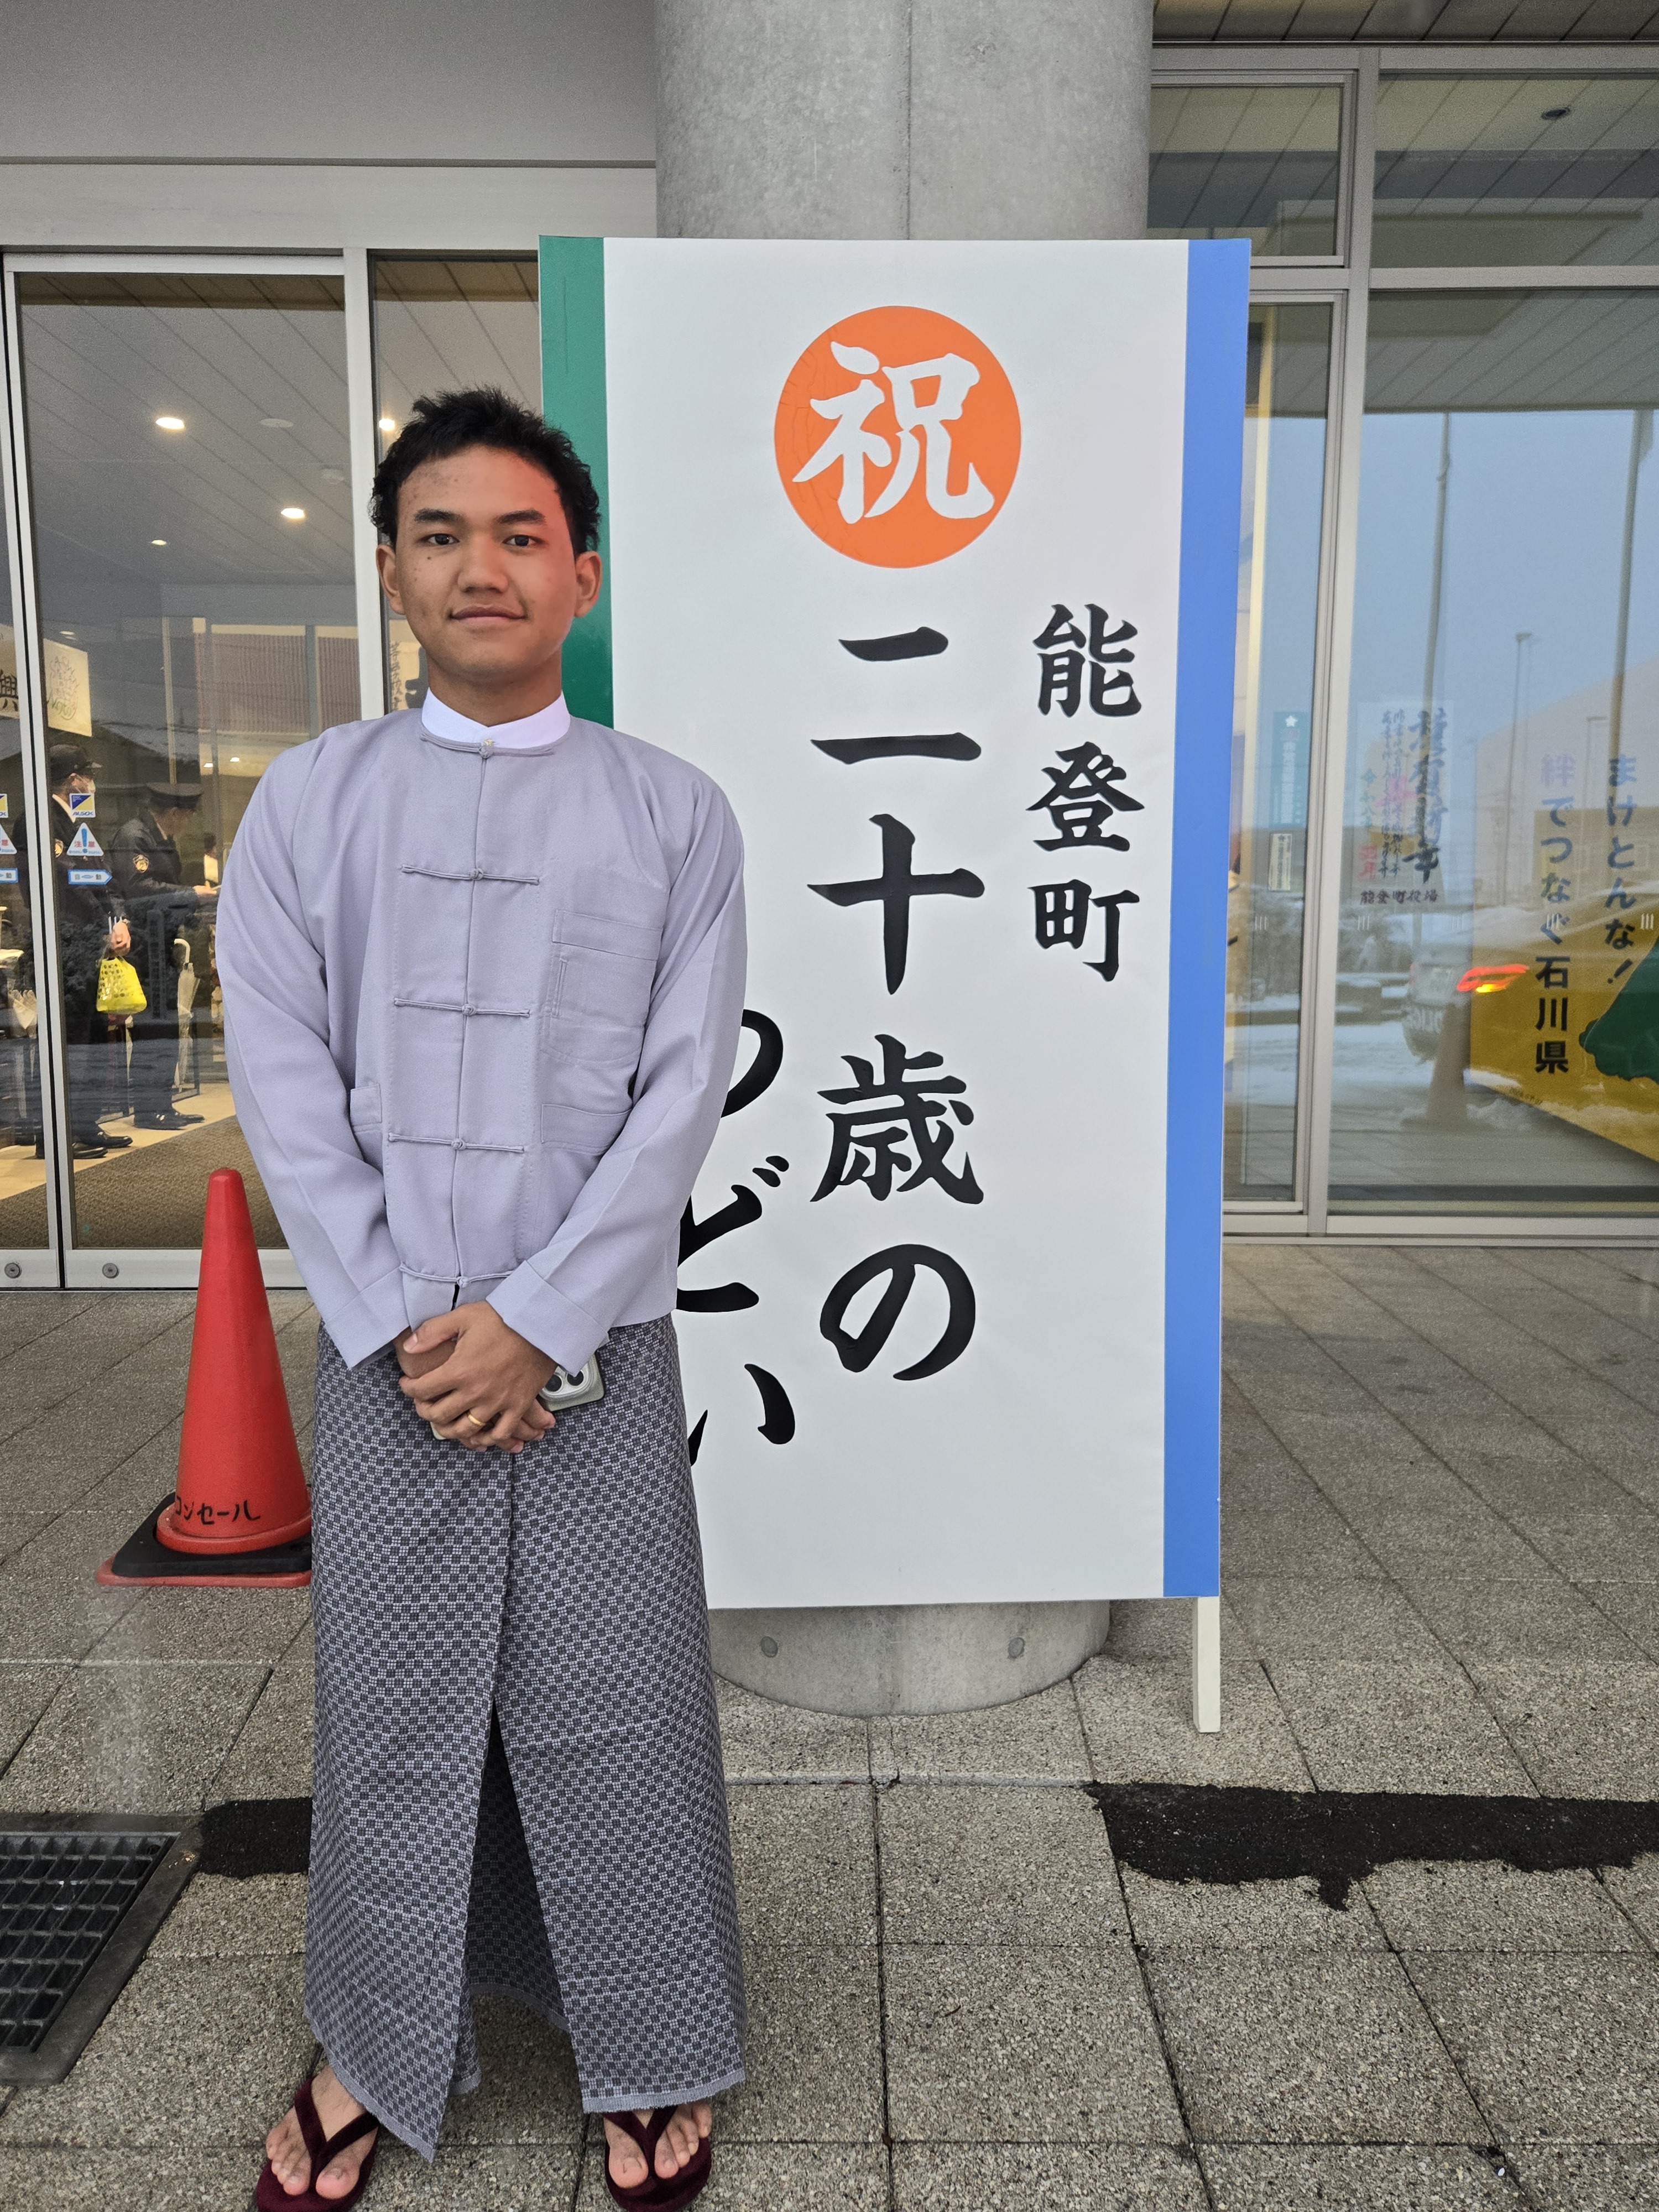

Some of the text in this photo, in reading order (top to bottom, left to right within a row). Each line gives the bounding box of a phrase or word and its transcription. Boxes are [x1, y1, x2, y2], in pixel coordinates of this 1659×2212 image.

[792, 341, 995, 524] 祝
[1026, 603, 1145, 982] 能登町
[1360, 888, 1439, 905] 能登町役場
[1534, 753, 1574, 1074] 絆でつなぐ石川県
[807, 626, 985, 1381] 二十歳の
